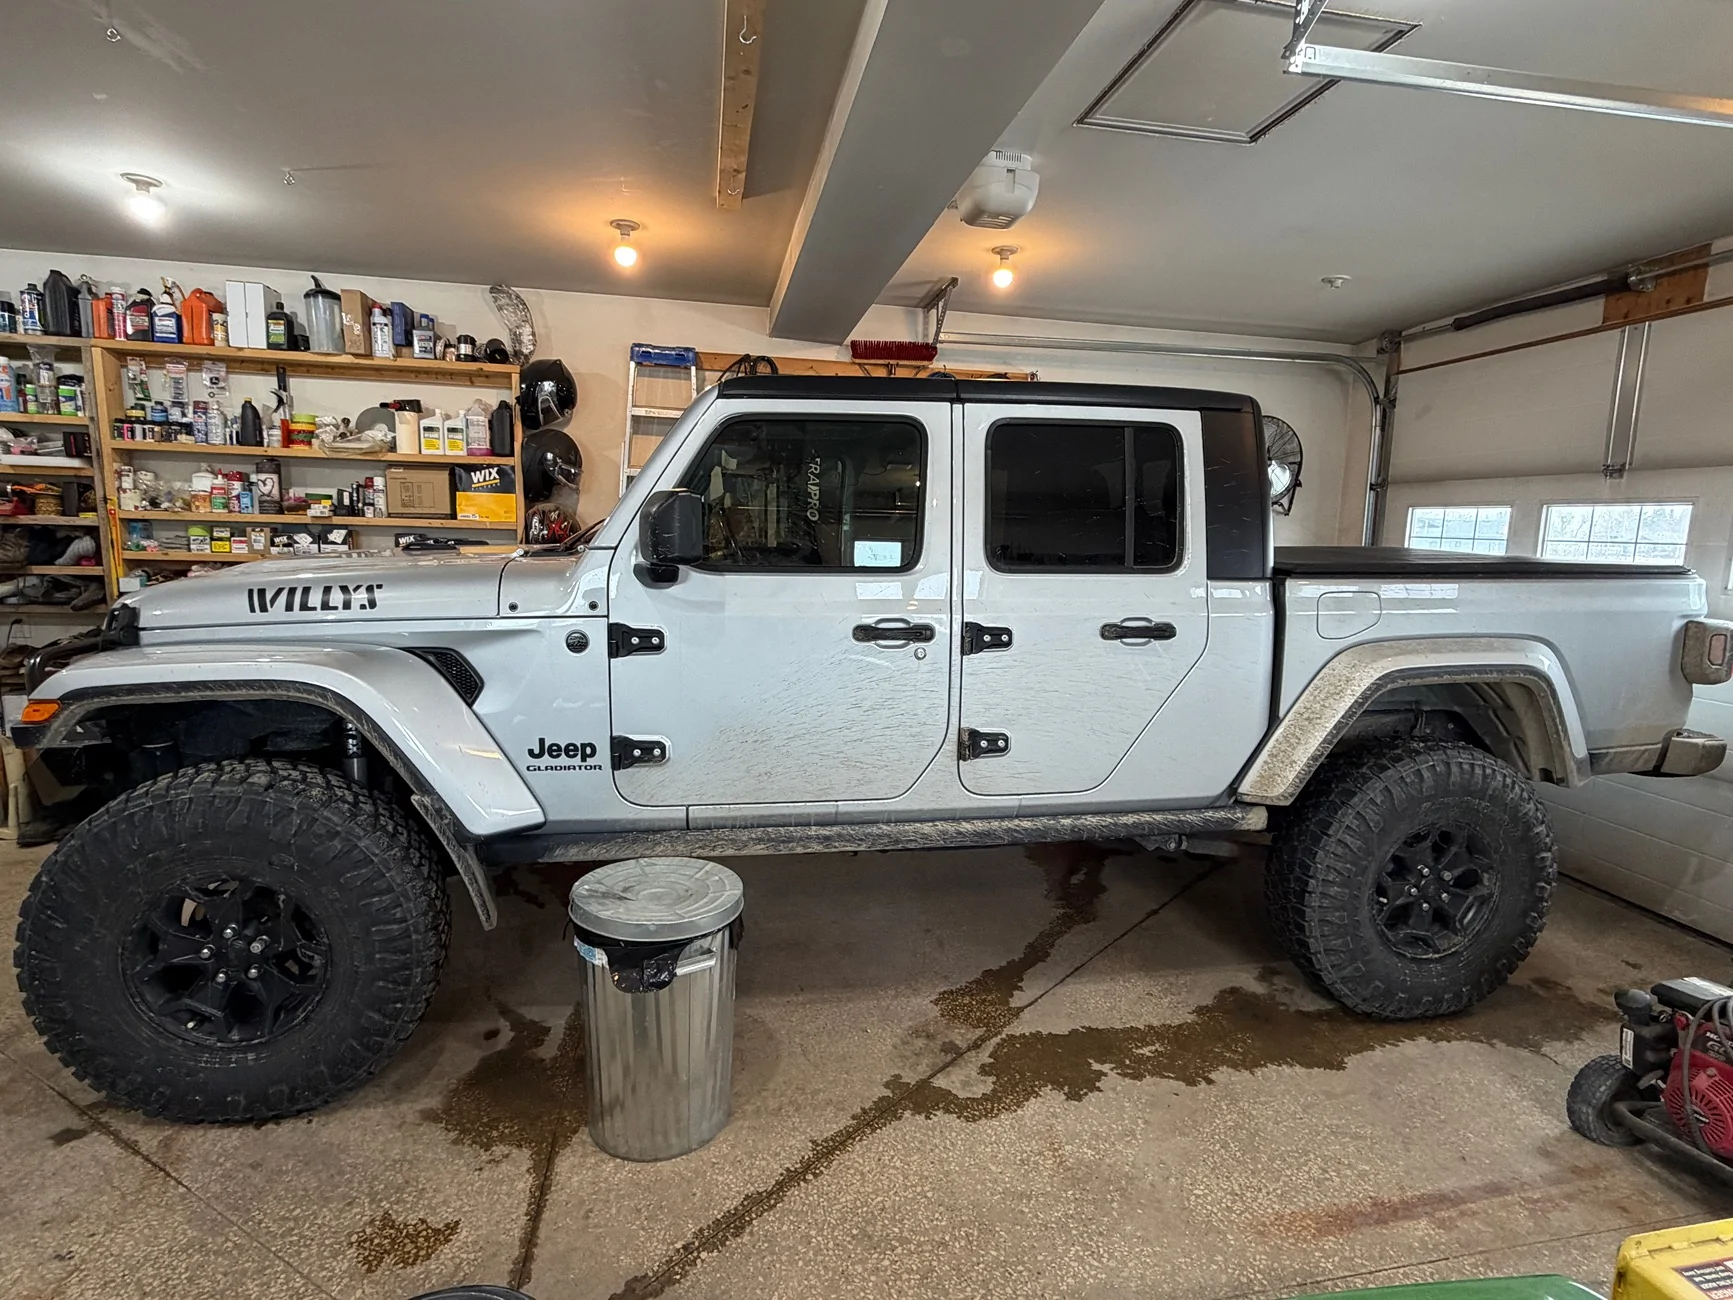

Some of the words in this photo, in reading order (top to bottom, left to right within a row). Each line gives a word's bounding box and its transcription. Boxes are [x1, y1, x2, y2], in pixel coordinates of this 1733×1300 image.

[471, 467, 500, 483] WIX
[398, 535, 415, 544] WIX
[247, 583, 384, 613] WILLYS
[527, 737, 597, 763] Jeep
[526, 764, 603, 772] GLADIATOR
